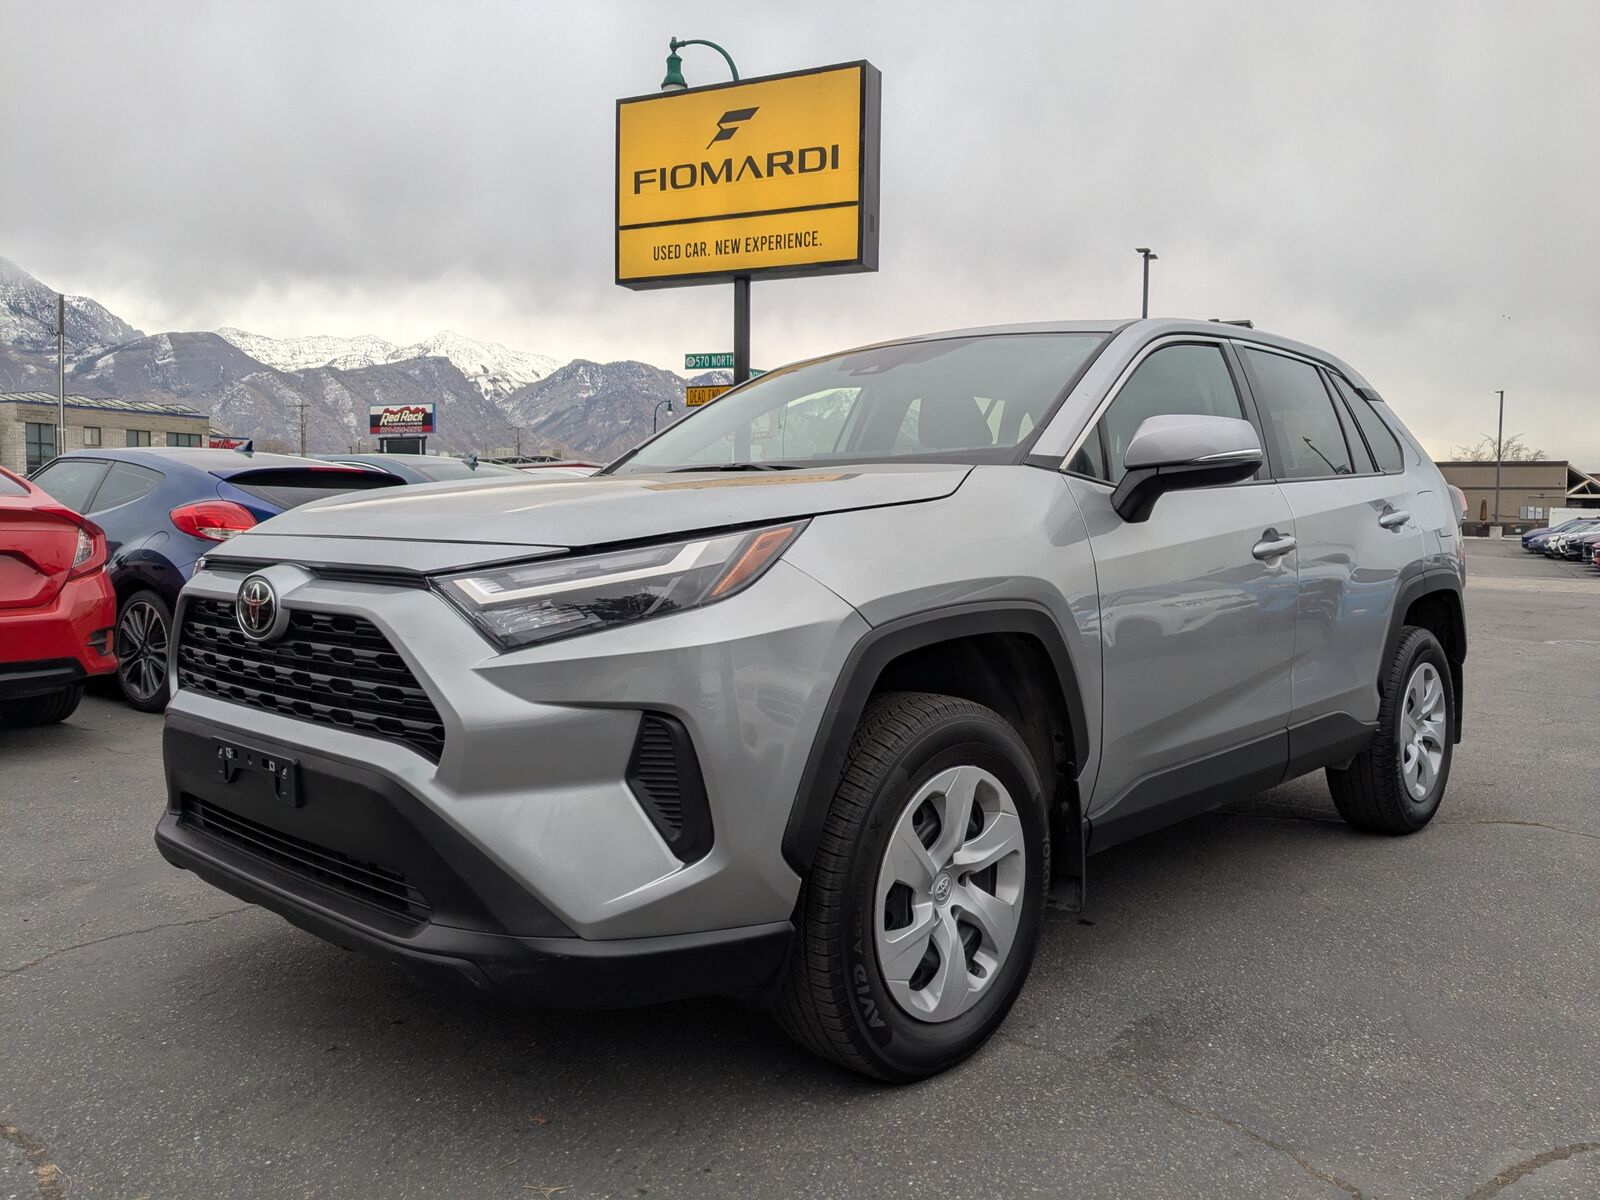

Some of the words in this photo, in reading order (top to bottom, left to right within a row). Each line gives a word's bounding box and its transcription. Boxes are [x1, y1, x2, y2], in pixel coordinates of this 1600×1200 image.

[633, 144, 839, 194] FIOMARDI
[653, 246, 681, 261] USED
[685, 241, 711, 257] CAR.
[715, 239, 741, 255] NEW
[745, 231, 822, 253] EXPERIENCE.
[695, 356, 710, 367] 570
[711, 355, 734, 366] NORTH
[690, 390, 705, 403] DEAD
[380, 411, 401, 425] Red
[401, 410, 424, 422] Rock
[853, 963, 886, 1028] AVID
